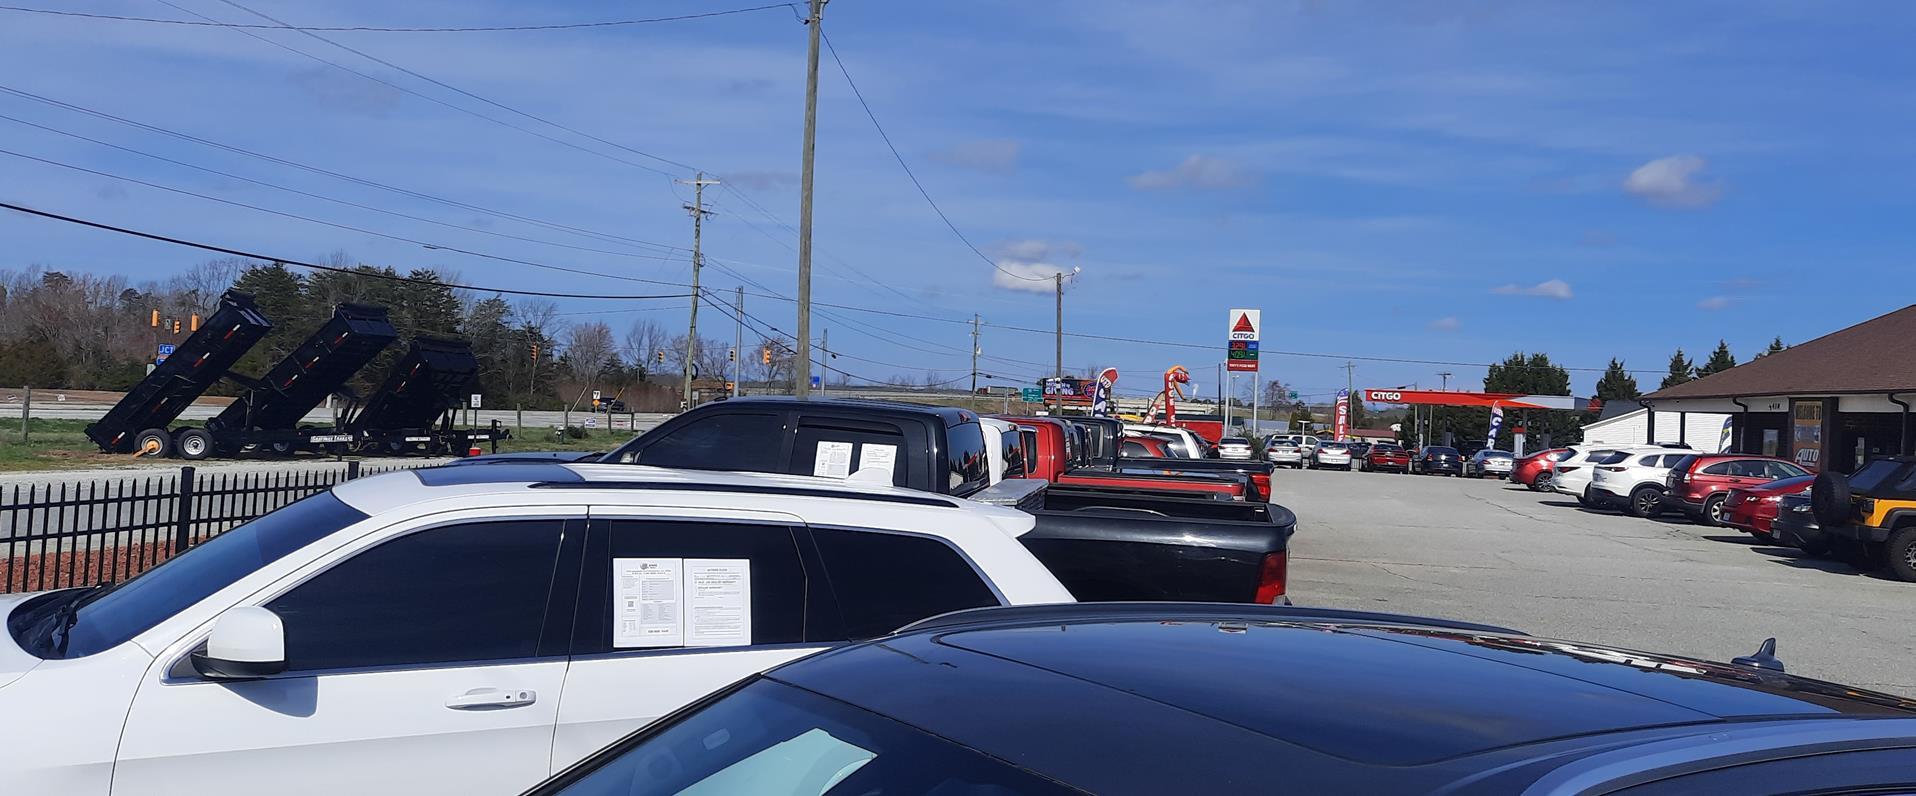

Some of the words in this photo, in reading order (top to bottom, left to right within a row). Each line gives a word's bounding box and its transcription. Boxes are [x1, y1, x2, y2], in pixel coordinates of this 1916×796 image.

[160, 346, 174, 354] JCT
[1046, 387, 1074, 396] GIVNG
[1371, 391, 1401, 401] CITGO
[1795, 448, 1820, 464] AUTO
